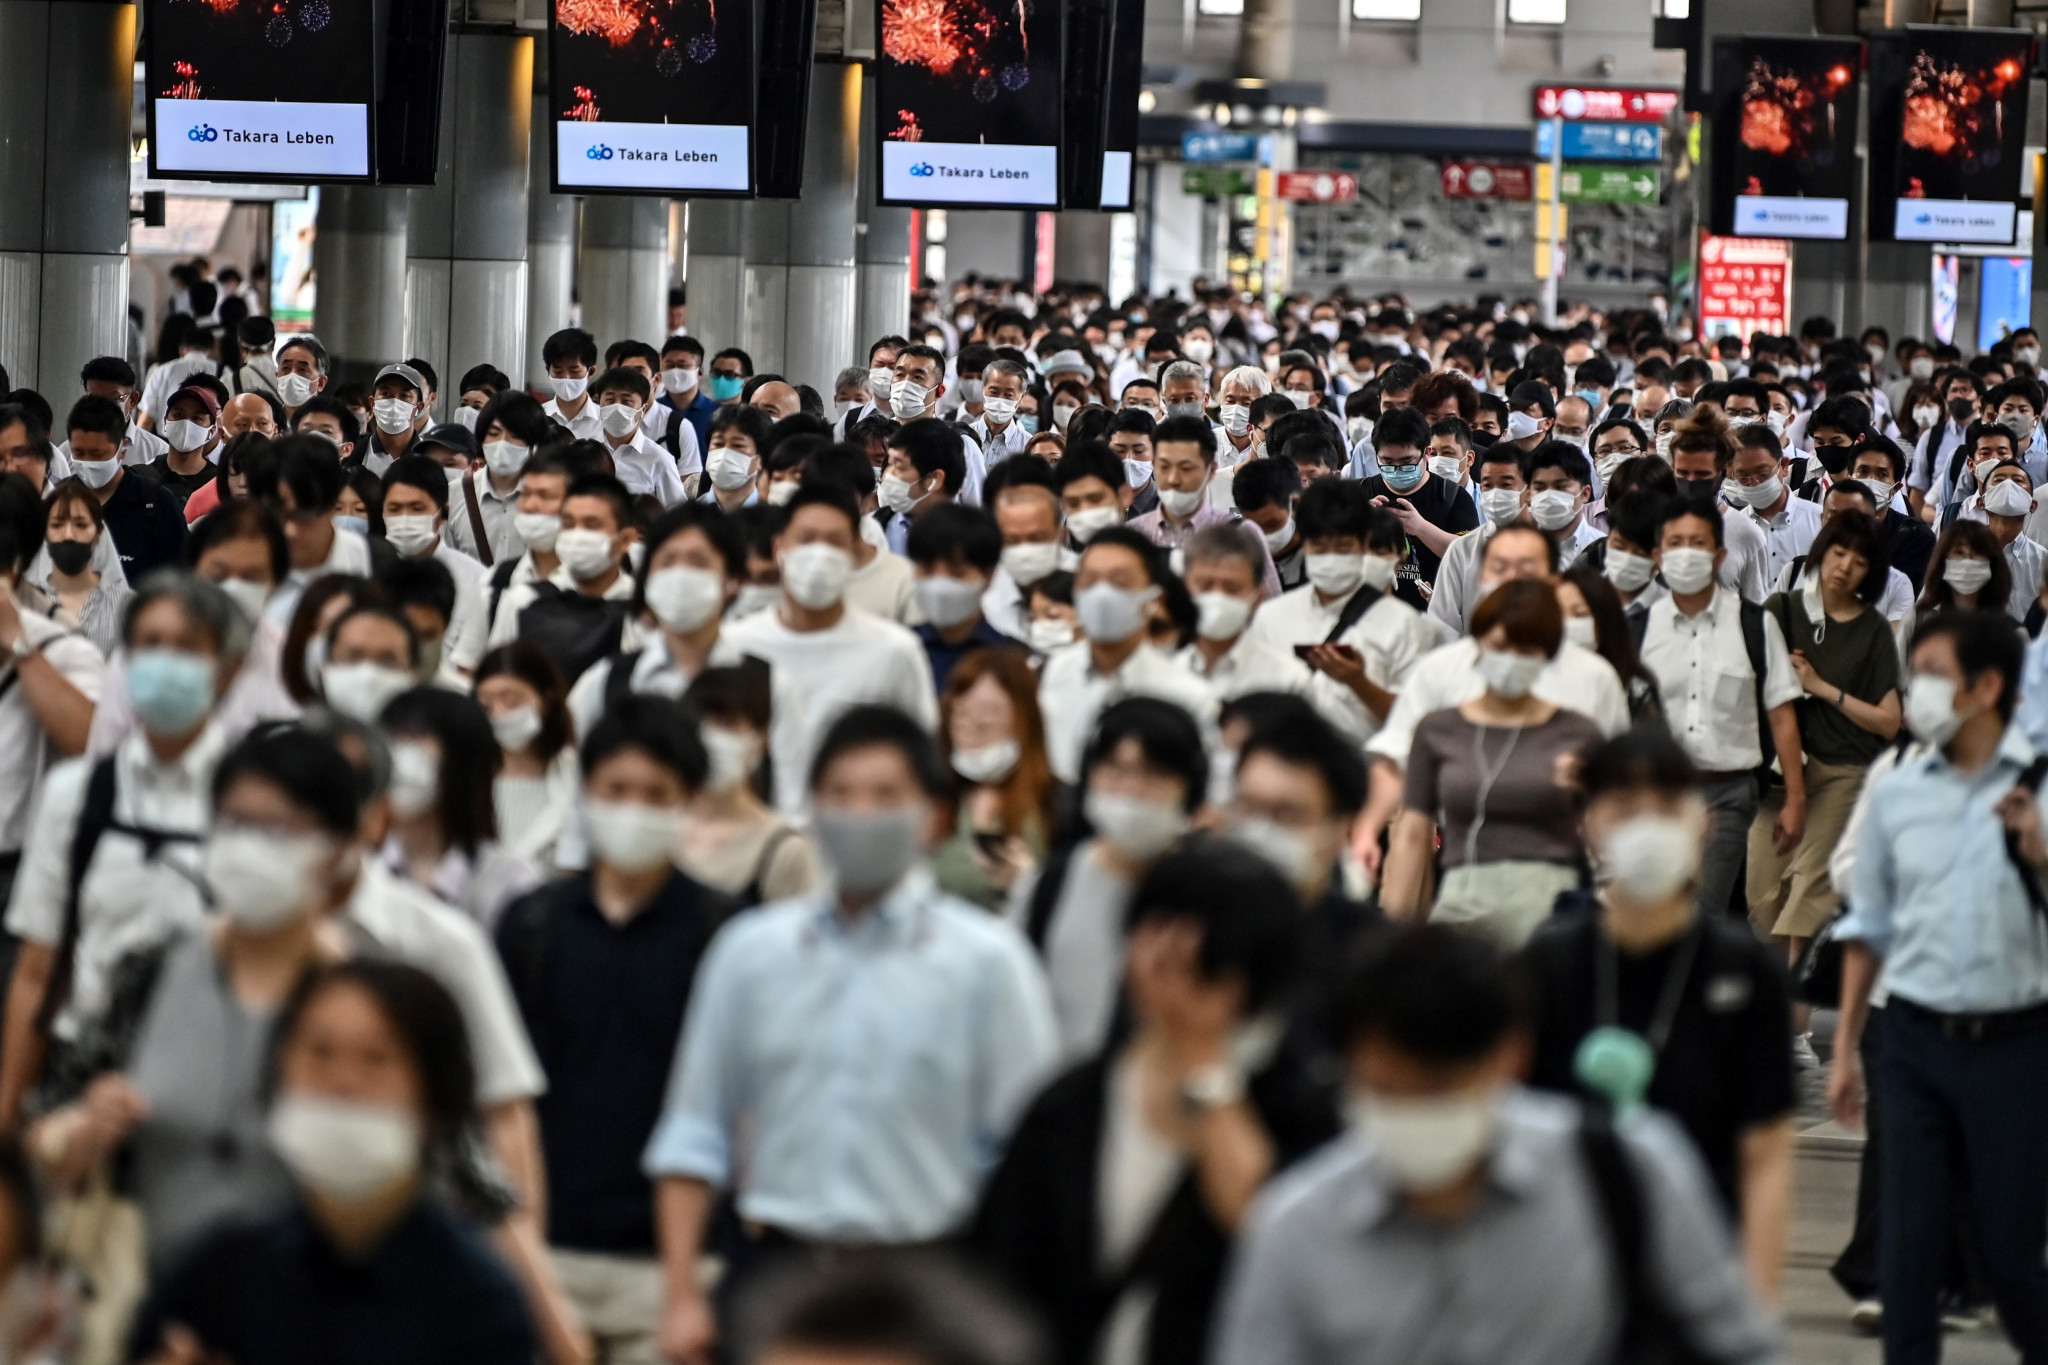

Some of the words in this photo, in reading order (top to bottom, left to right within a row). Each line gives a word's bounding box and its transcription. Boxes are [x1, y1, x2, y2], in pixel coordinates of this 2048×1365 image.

[223, 129, 278, 143] Takara
[286, 131, 334, 144] Leben
[618, 148, 668, 161] Takara
[674, 150, 718, 162] Leben
[939, 166, 984, 178] Takara
[990, 168, 1029, 179] Leben
[1401, 564, 1420, 572] SERK
[1395, 571, 1422, 580] ONTROL
